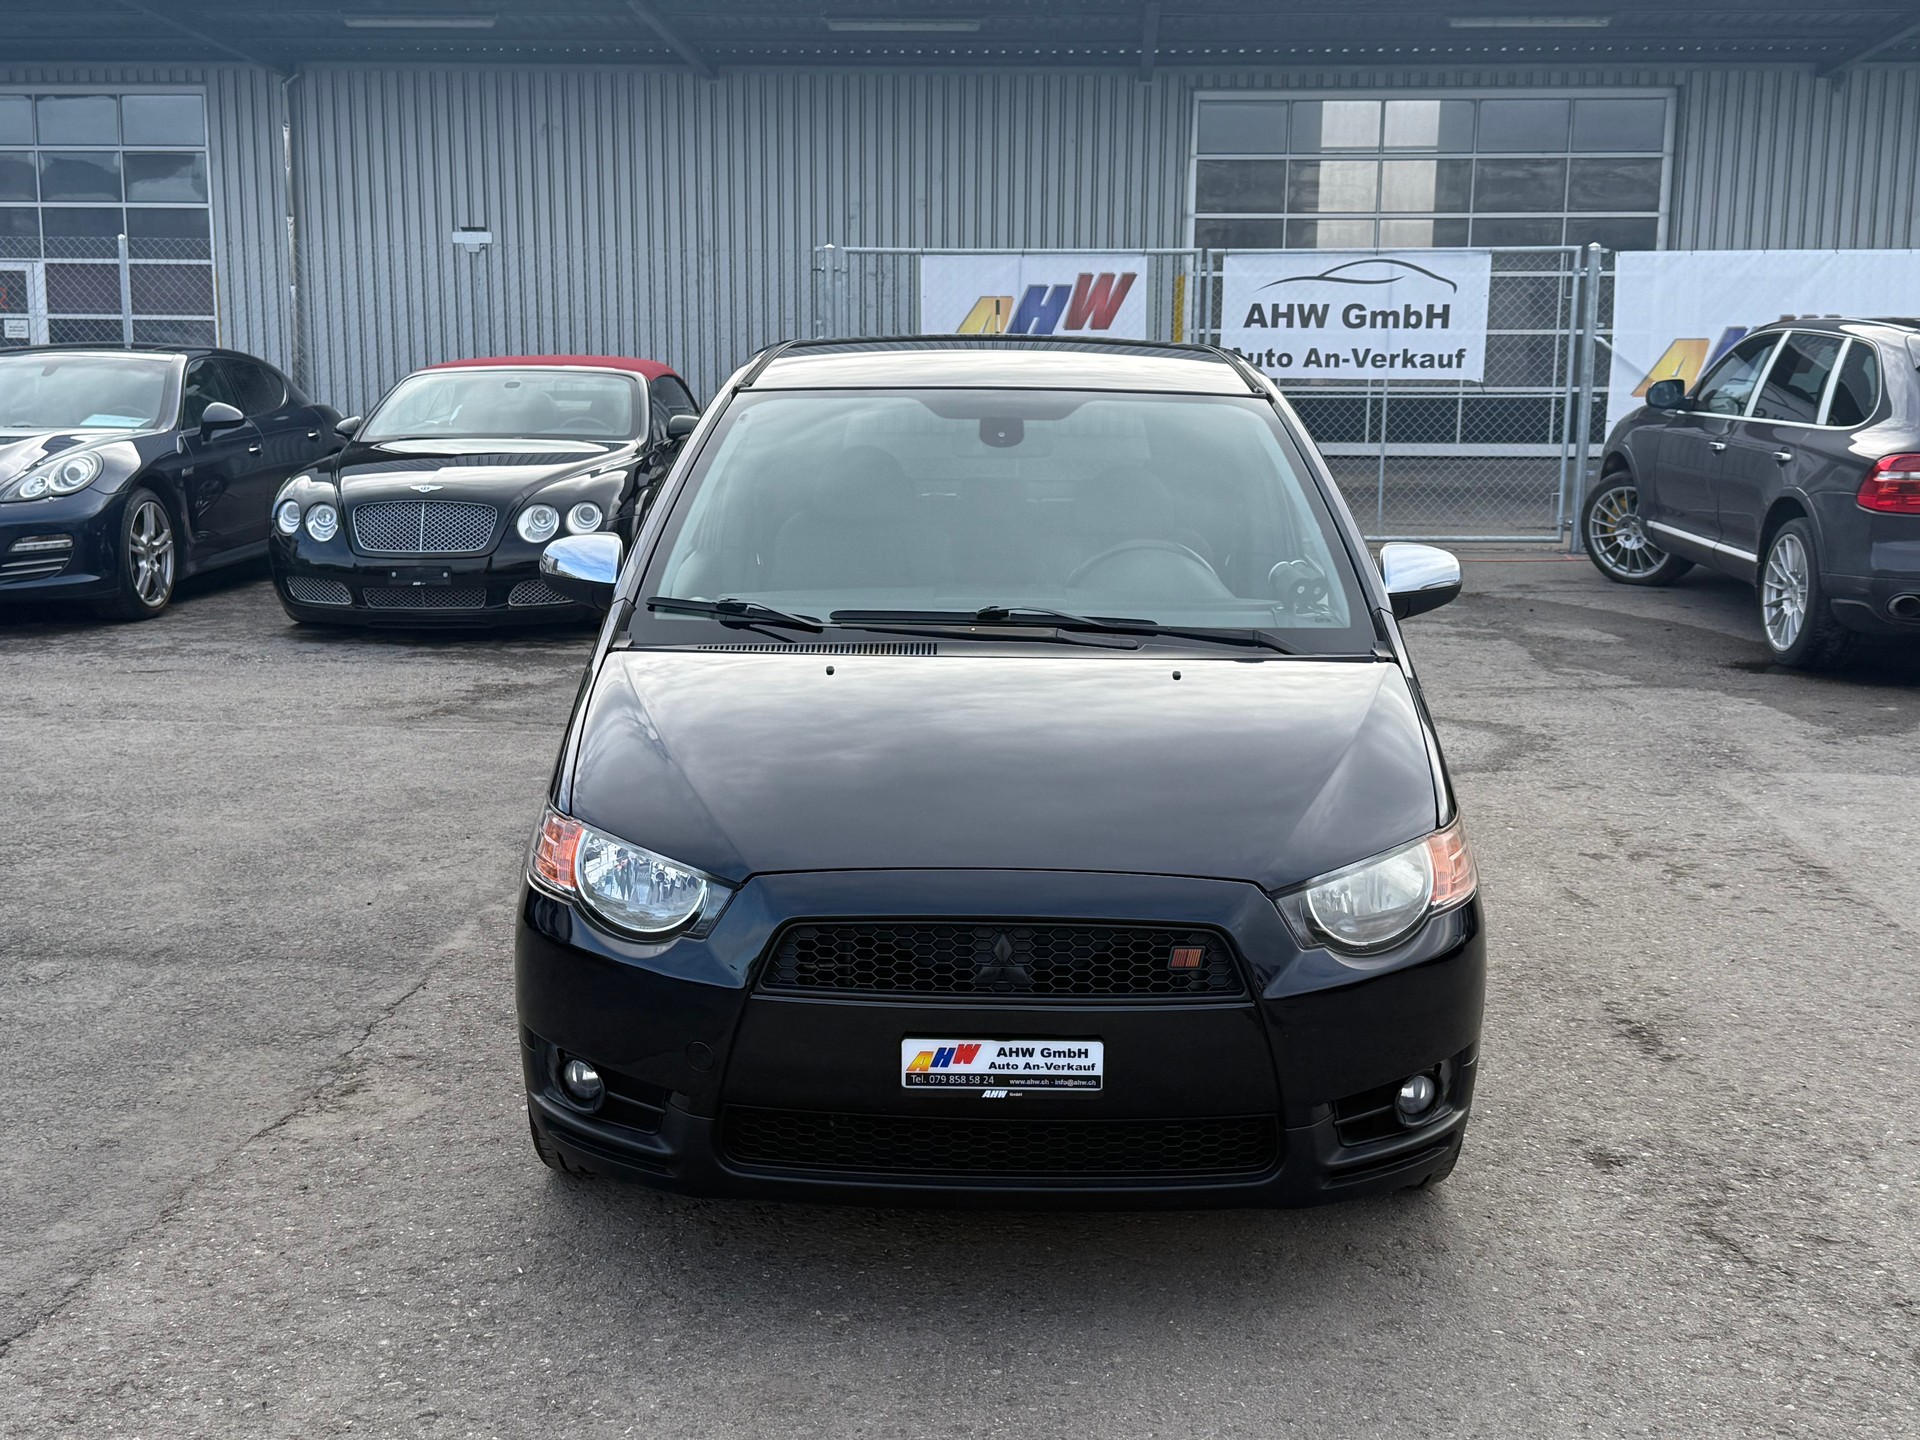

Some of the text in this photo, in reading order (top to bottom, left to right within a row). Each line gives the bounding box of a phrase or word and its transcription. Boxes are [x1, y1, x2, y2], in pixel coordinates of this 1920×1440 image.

[955, 272, 1138, 335] AHW
[1243, 303, 1451, 330] AHW GmbH
[1232, 347, 1467, 369] uto An-Verkauf
[906, 1043, 982, 1072] AHW
[996, 1047, 1089, 1059] AHW GmbH
[988, 1061, 1097, 1072] Auto An-Verkauf
[911, 1074, 995, 1084] Tel. 079 858 58 24
[1009, 1078, 1050, 1086] www.ahw.ch
[1054, 1078, 1097, 1087] info@ahw.ch
[981, 1089, 1008, 1099] AHW
